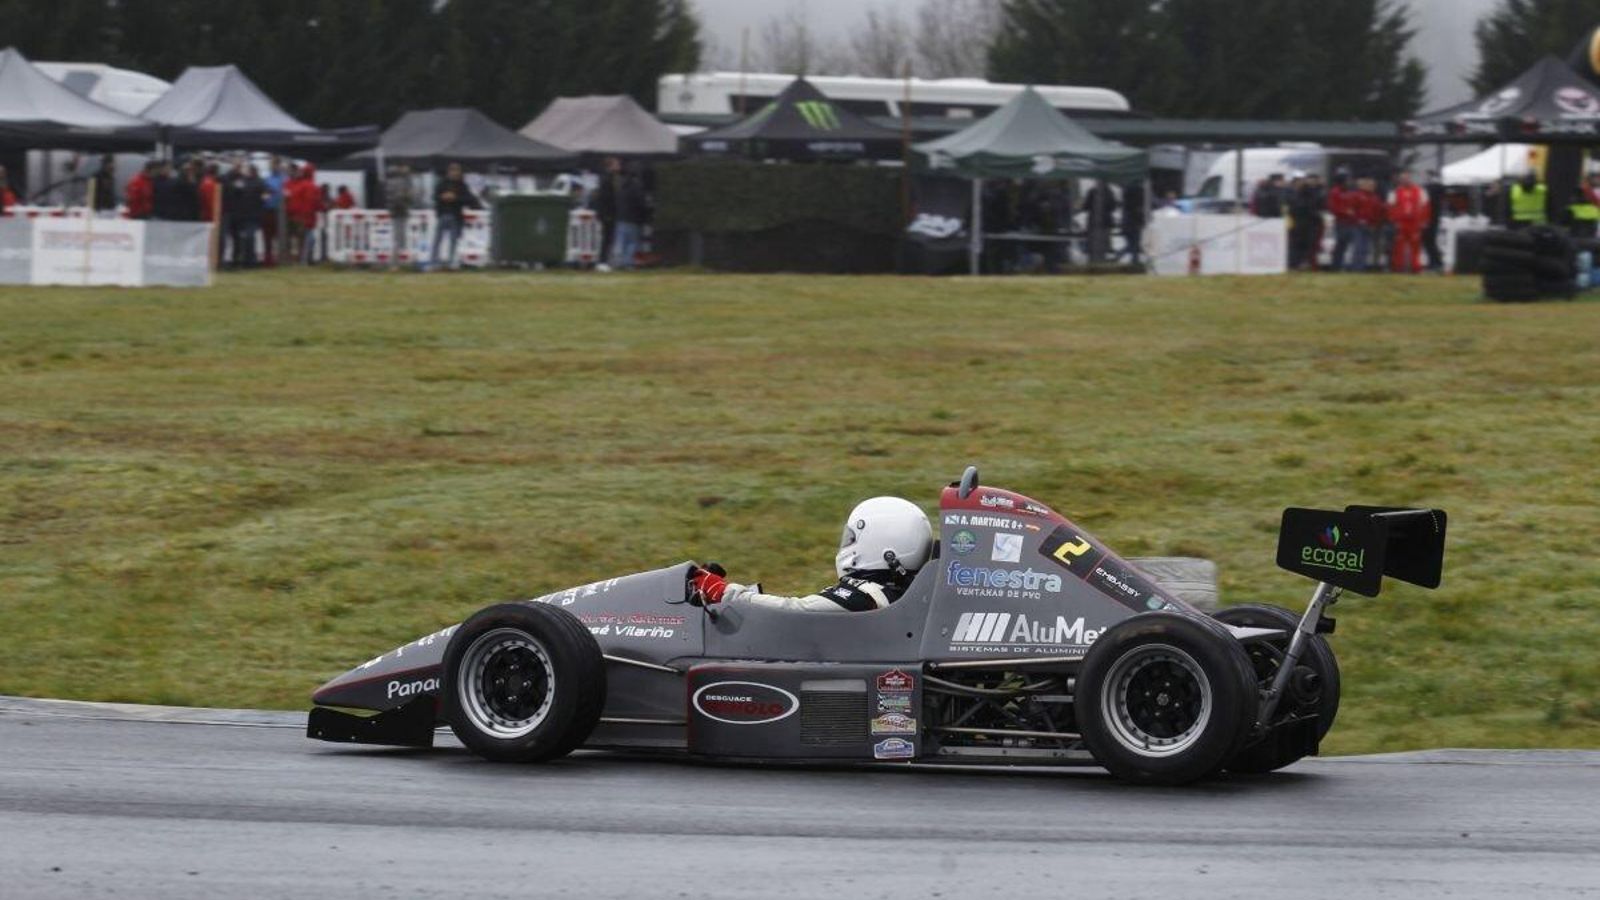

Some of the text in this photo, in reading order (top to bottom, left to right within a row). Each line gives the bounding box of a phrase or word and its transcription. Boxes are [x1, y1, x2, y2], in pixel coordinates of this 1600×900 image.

[970, 515, 1010, 529] MARTINEZ
[1053, 535, 1091, 565] 2
[1301, 546, 1365, 571] ecogal
[947, 560, 1062, 593] fenestra
[1095, 567, 1141, 598] EMBASSY
[956, 587, 1004, 598] VENTANAS
[1007, 590, 1020, 598] DE
[615, 625, 674, 638] Vilariño
[949, 645, 1008, 653] SISTEMAS
[1034, 647, 1088, 655] ALUMINI
[705, 694, 753, 702] DESGUACE
